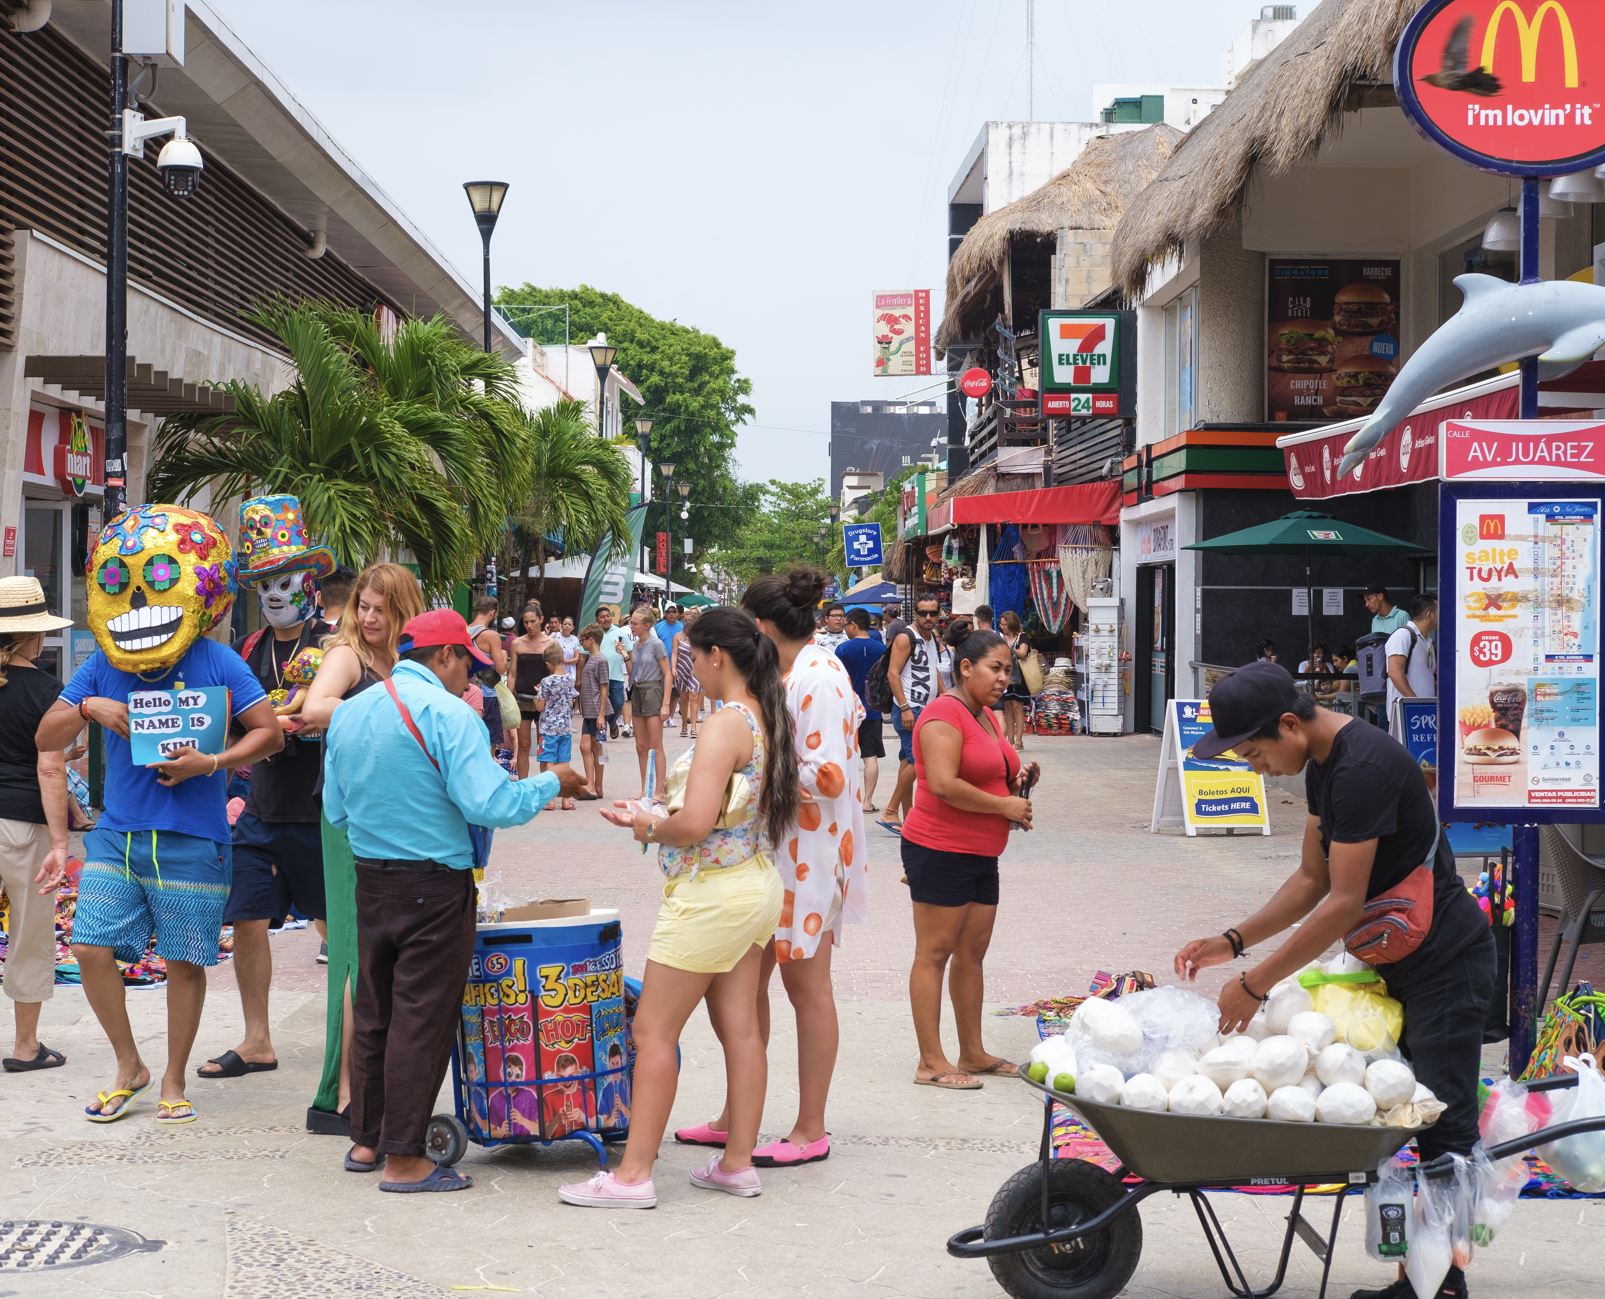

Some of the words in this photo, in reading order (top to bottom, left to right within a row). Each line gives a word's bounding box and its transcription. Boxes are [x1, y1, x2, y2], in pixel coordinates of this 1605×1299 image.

[1467, 104, 1503, 126] i'm
[1506, 103, 1571, 126] lovin'
[1362, 267, 1393, 276] BARBECUE
[1288, 297, 1311, 308] CLUB
[918, 291, 927, 338] MEXICAN
[1059, 323, 1106, 385] 7
[1372, 341, 1394, 356] NUEVA
[919, 345, 927, 372] FOOD
[964, 378, 988, 388] Coca-Cola
[1290, 379, 1328, 389] CHIPOTLE
[1047, 400, 1070, 408] ABIERTO
[1071, 397, 1092, 412] 24
[1095, 400, 1114, 408] HORAS
[1294, 396, 1323, 406] RANCH
[1447, 430, 1470, 438] CALLE
[1467, 441, 1501, 462] AV.
[1507, 438, 1594, 462] JUÁREZ
[67, 454, 91, 477] mart
[847, 527, 877, 537] Drugstore
[850, 553, 878, 562] Farmacia
[1464, 547, 1519, 566] salte
[1465, 561, 1519, 582] TUYA
[1473, 641, 1502, 661] $39
[133, 697, 171, 709] Hello
[178, 695, 201, 708] MY
[134, 718, 180, 731] NAME
[190, 717, 205, 727] IS
[1473, 775, 1512, 786] GOURMET
[1198, 788, 1228, 796] Boletos
[1201, 803, 1229, 812] Tickets
[1230, 801, 1251, 810] HERE
[489, 956, 505, 970] $5
[540, 965, 568, 1008] 3
[541, 1018, 592, 1044] HOT
[1250, 1177, 1289, 1185] PRETUL
